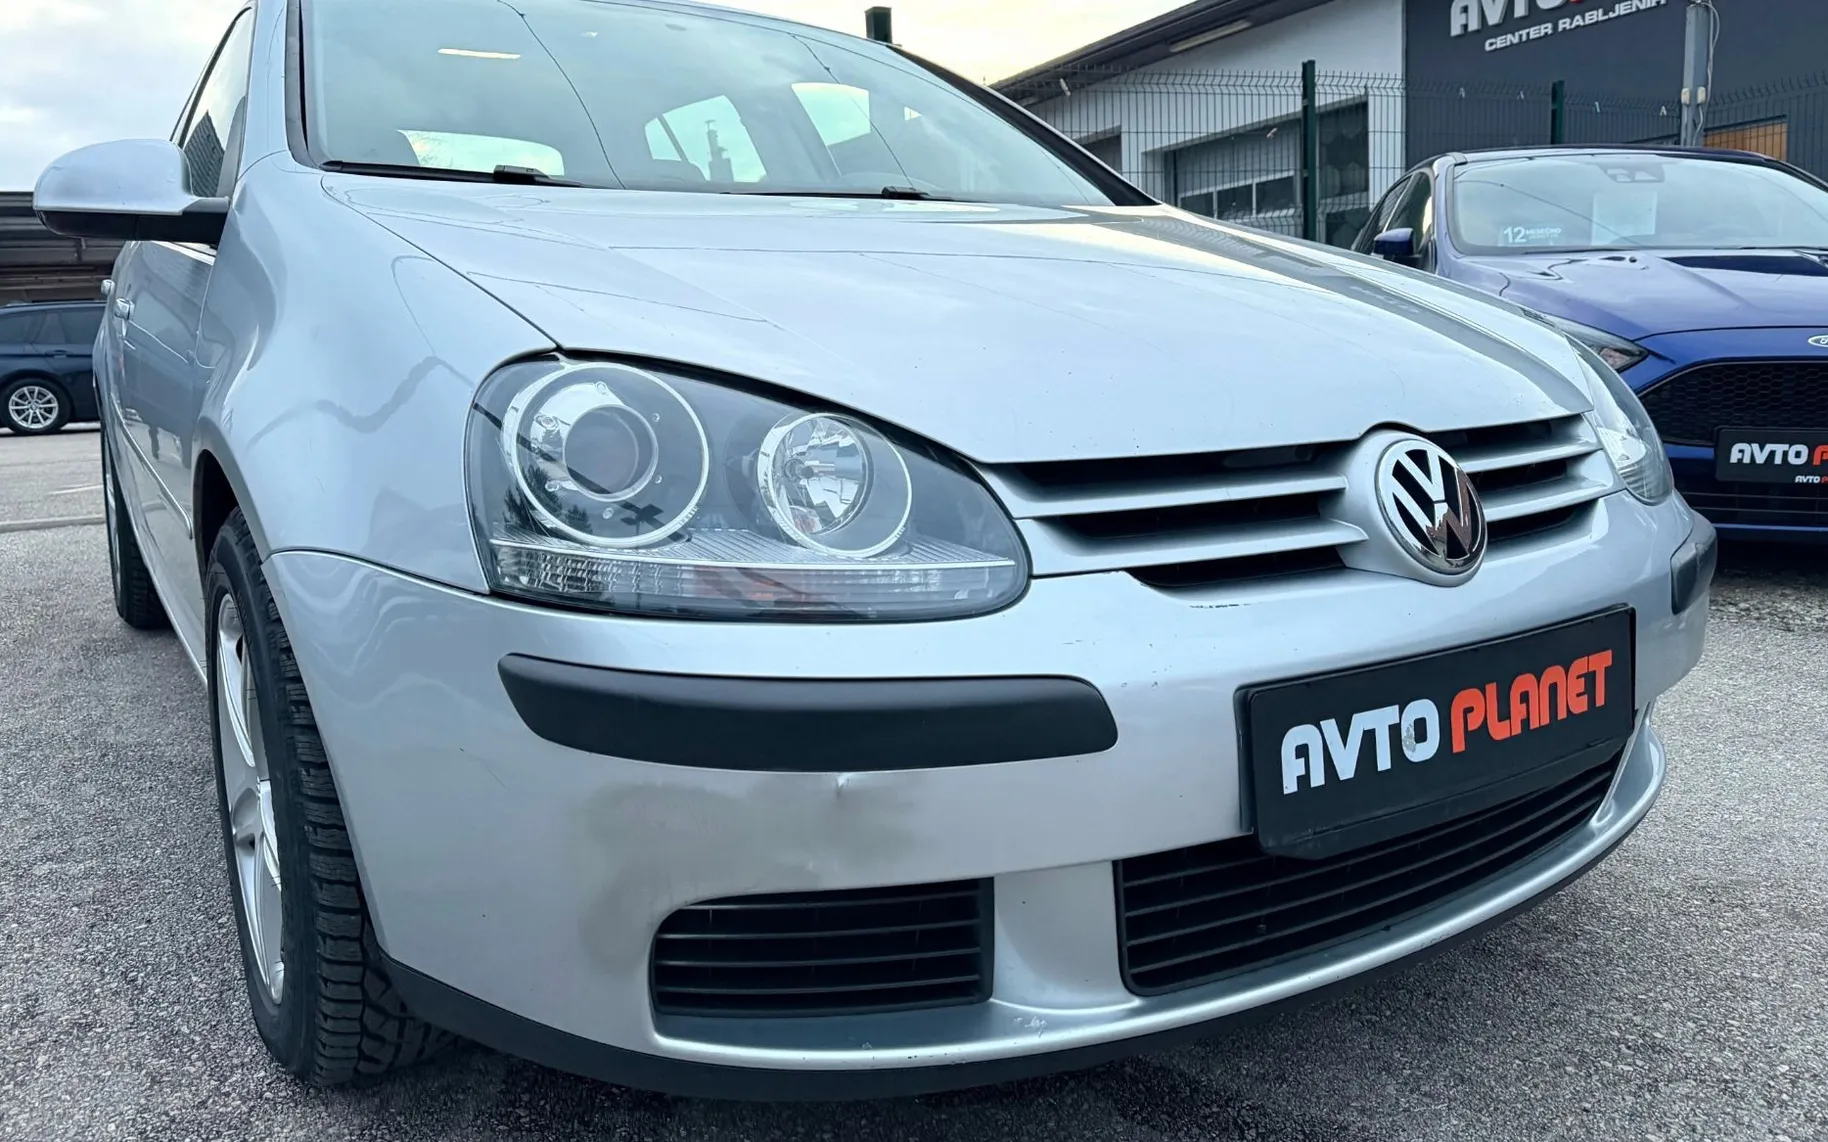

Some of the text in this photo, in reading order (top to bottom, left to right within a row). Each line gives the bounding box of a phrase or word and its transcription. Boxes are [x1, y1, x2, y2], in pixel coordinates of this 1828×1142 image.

[1450, 0, 1564, 37] AV
[1484, 22, 1553, 52] CENTER
[1503, 226, 1527, 244] 12
[1729, 443, 1809, 465] AVTO
[1794, 475, 1820, 483] AVTO
[1280, 649, 1613, 796] AVTO PLANET
